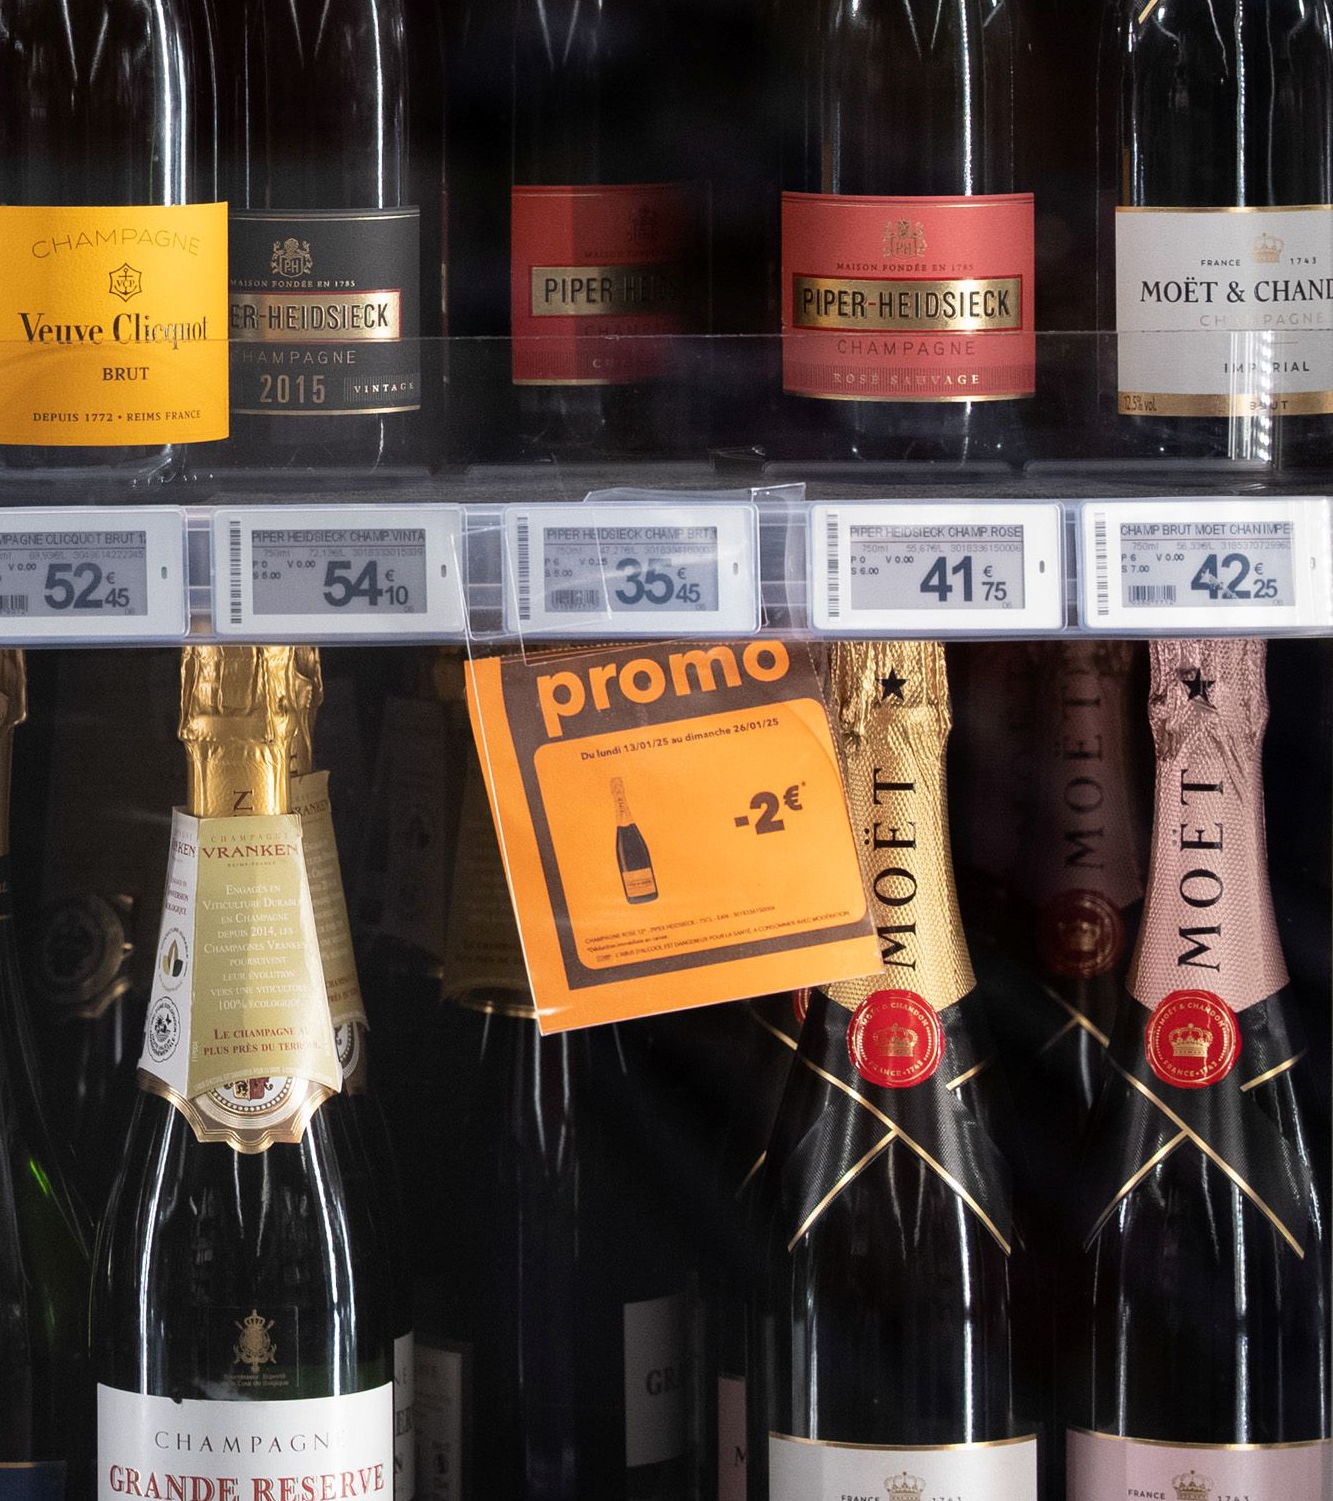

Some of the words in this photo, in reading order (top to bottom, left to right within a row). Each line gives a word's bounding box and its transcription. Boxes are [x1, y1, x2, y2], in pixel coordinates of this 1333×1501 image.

[32, 228, 200, 258] CHAMPAGNE
[837, 263, 878, 272] MAISON
[883, 261, 926, 272] FONDÉE
[1201, 259, 1241, 267] FRANCE
[271, 278, 313, 288] FONDÉE
[1140, 276, 1219, 304] MOËT
[801, 289, 1012, 320] PIPER-HEIDSIECK
[18, 311, 104, 345] Veuve
[112, 311, 208, 350] Clicquot
[837, 339, 976, 356] CHAMPAGNE
[103, 366, 149, 380] BRUT
[353, 382, 414, 393] VINTAGE
[261, 374, 325, 403] 2015
[33, 412, 79, 422] DEPUIS
[127, 410, 161, 422] REIMS
[43, 563, 104, 609] 52
[324, 560, 382, 607] 54
[386, 585, 408, 605] 10
[615, 558, 674, 605] 35
[675, 583, 700, 602] 45
[920, 556, 973, 603] 41
[982, 581, 1007, 602] 75
[1190, 553, 1251, 600] 42
[1253, 579, 1278, 599] 25
[536, 639, 789, 738] promo
[581, 748, 596, 761] Du
[596, 744, 622, 759] lundi
[623, 737, 669, 754] 13/01/25
[671, 735, 683, 745] au
[684, 726, 732, 743] dimanche
[733, 717, 779, 735] 26/01/25
[202, 842, 299, 859] VRANKEN
[863, 768, 918, 970] MOËT
[1171, 768, 1224, 971] MOËT
[203, 1043, 230, 1056] PLUS
[110, 1464, 239, 1501] GRANDE
[253, 1464, 385, 1501] RESERVE
[1128, 1489, 1165, 1500] FRANCE
